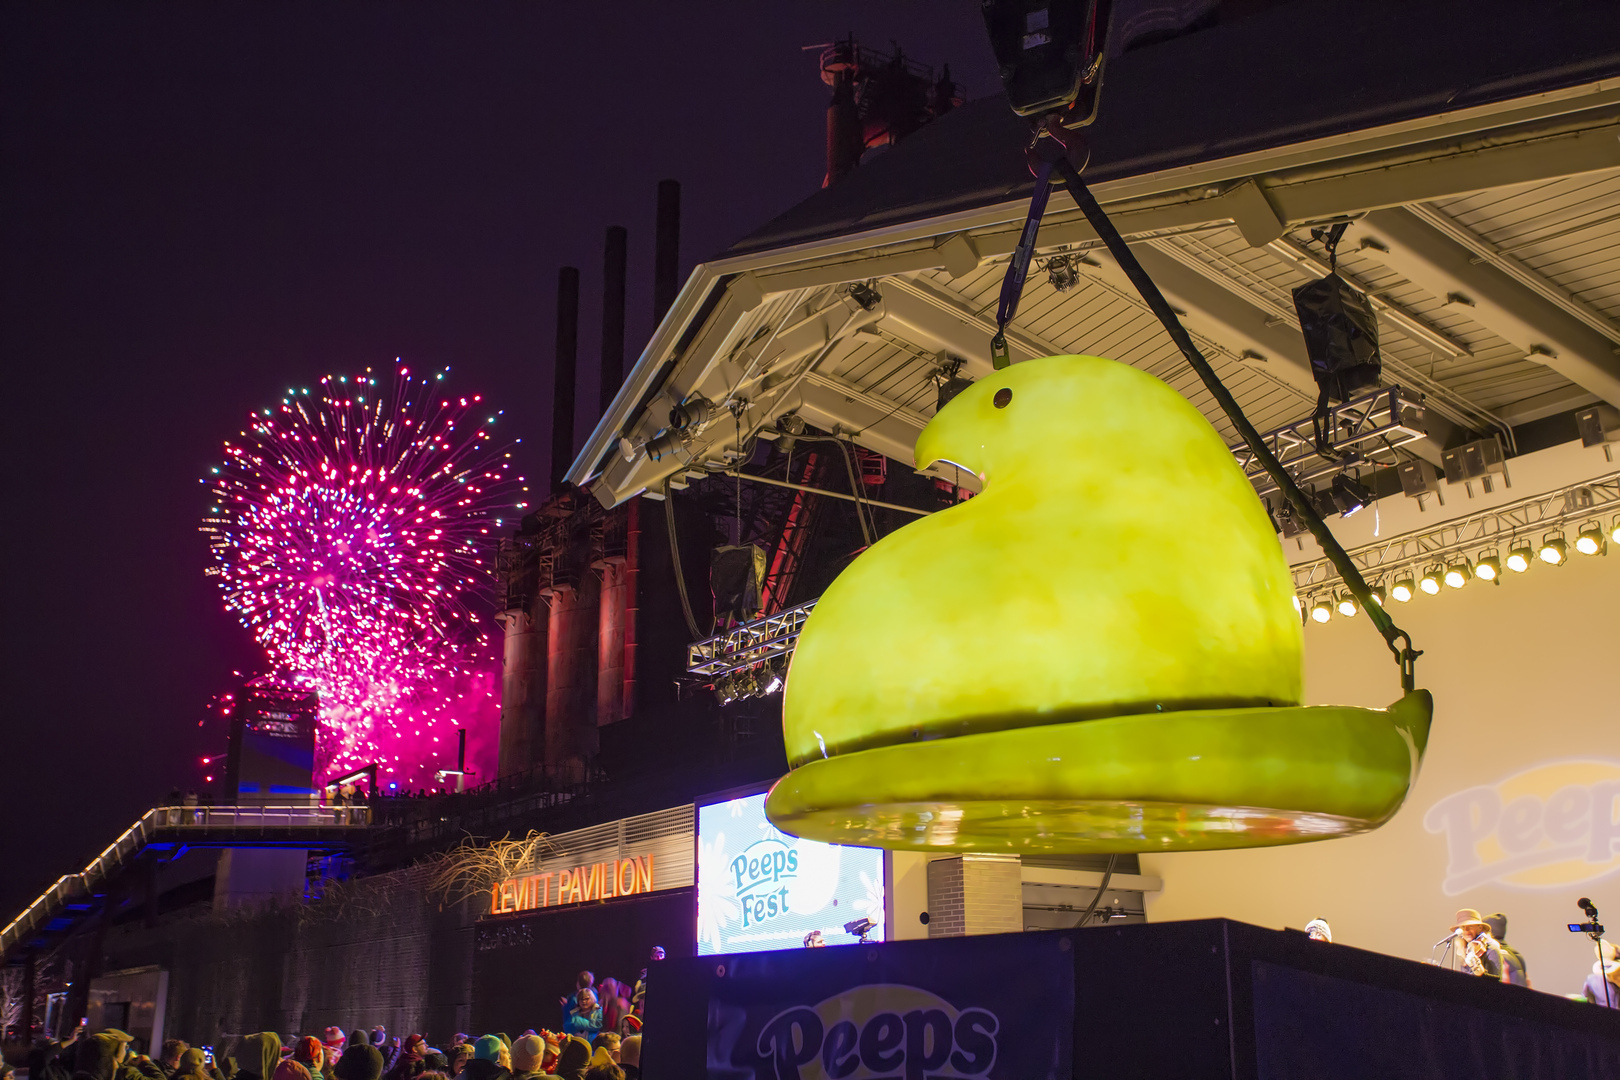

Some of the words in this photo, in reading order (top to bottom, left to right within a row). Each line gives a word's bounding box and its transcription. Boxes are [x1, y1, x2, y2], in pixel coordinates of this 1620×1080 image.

[491, 872, 555, 914] LEVITT
[558, 853, 654, 905] PAVILION
[730, 849, 798, 890] Peeps
[741, 885, 789, 928] Fest
[757, 1006, 998, 1080] Peeps
